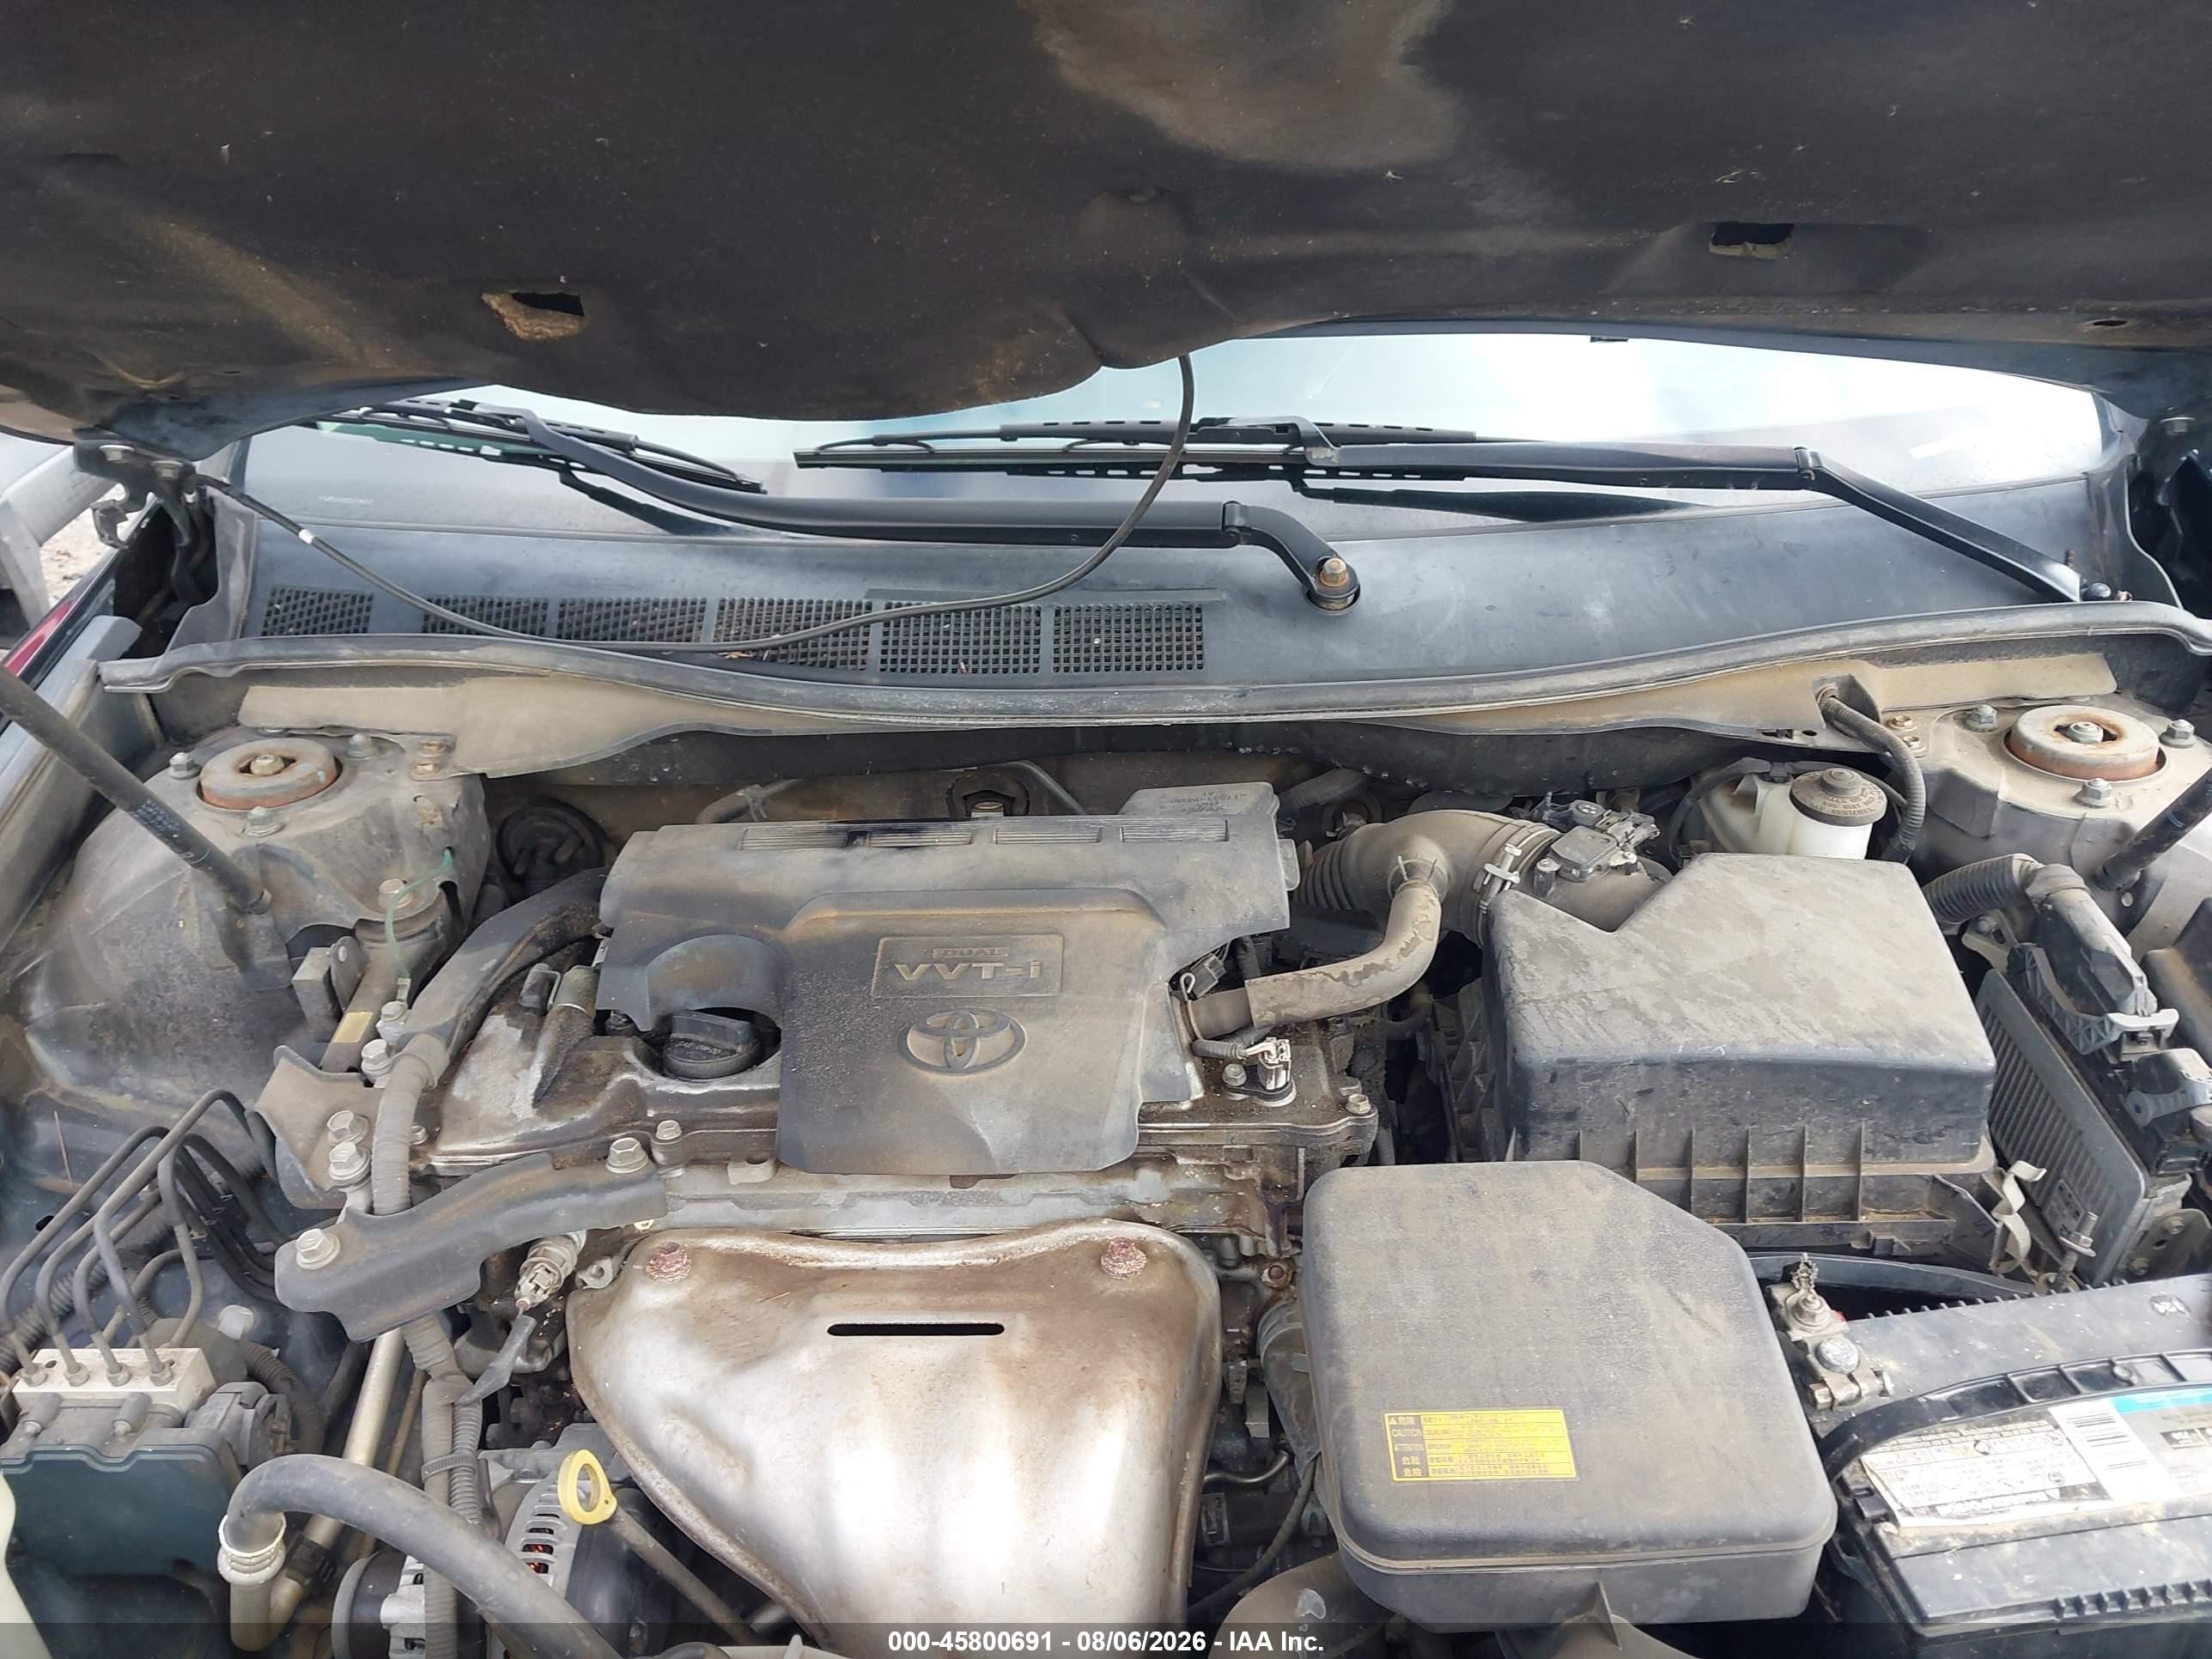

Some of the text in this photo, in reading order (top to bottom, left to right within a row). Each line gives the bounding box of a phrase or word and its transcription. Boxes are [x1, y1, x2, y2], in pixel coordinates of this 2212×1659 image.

[944, 948, 1003, 957] DUAL
[895, 961, 1042, 981] VVT-i
[1391, 1429, 1422, 1437] CAUTION
